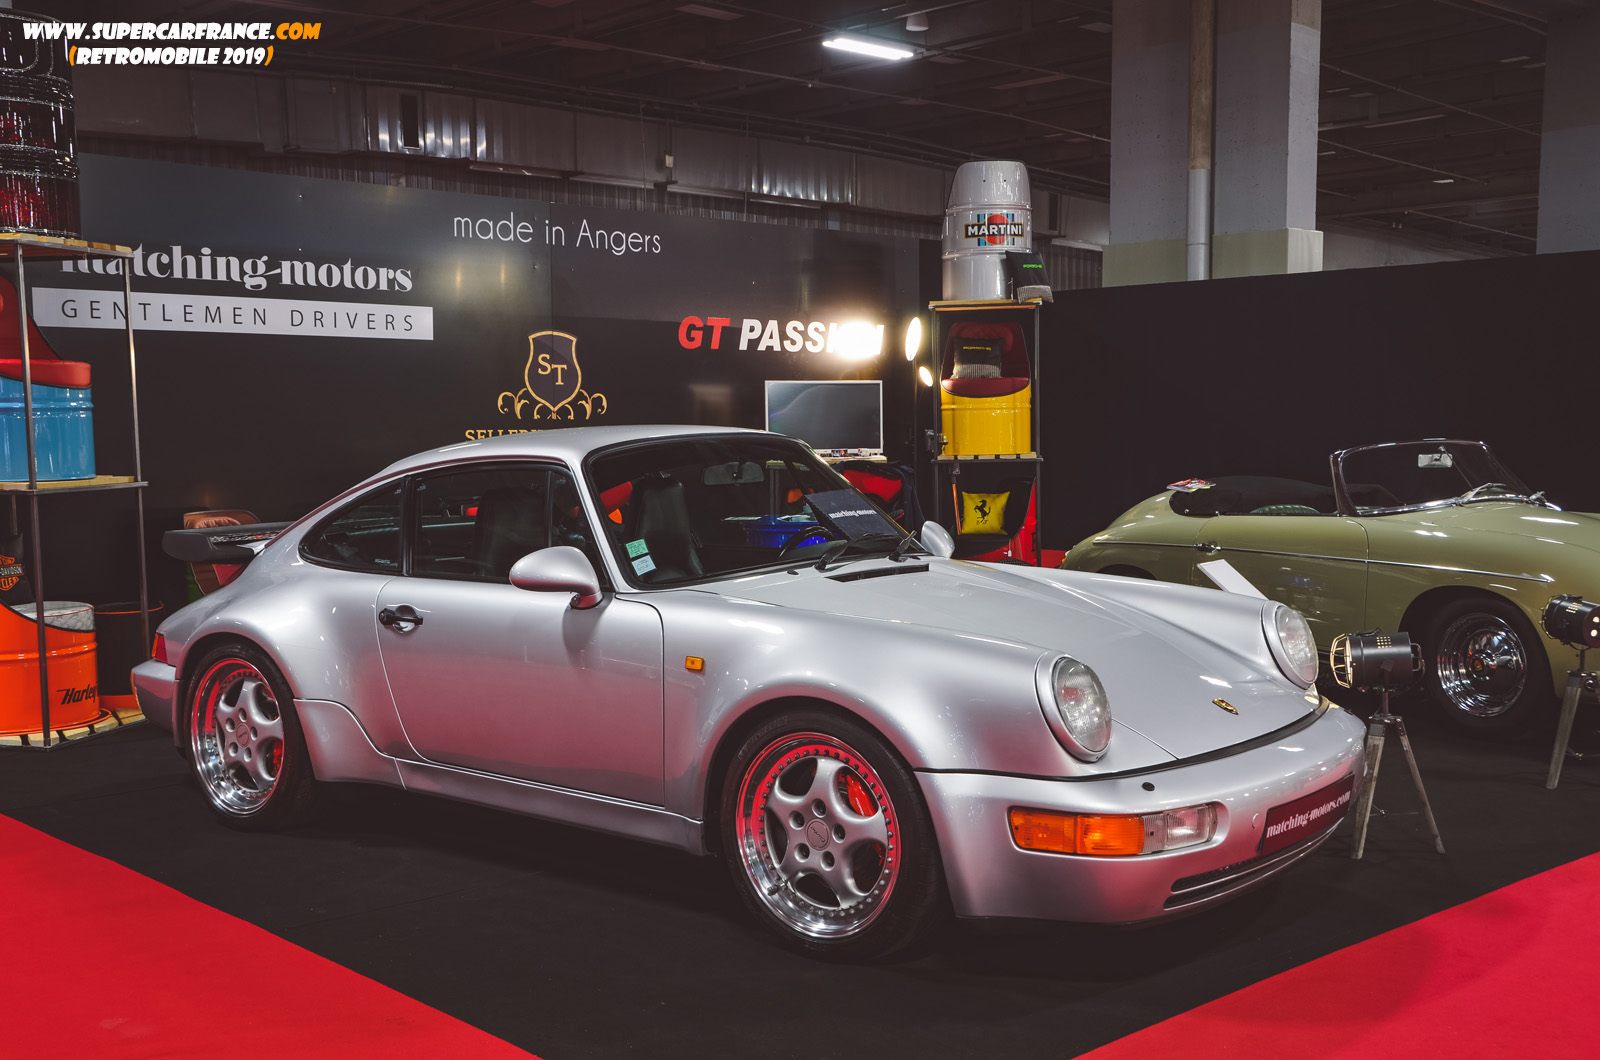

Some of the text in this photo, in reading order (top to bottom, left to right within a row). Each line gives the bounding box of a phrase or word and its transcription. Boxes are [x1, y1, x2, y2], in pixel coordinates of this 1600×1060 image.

[453, 212, 661, 255] made in Angers
[967, 224, 1022, 236] MARTINI
[61, 299, 413, 332] GENTLEMEN DRIVERS
[678, 316, 884, 353] GT PASSI
[1266, 790, 1351, 838] matching-motors.com
